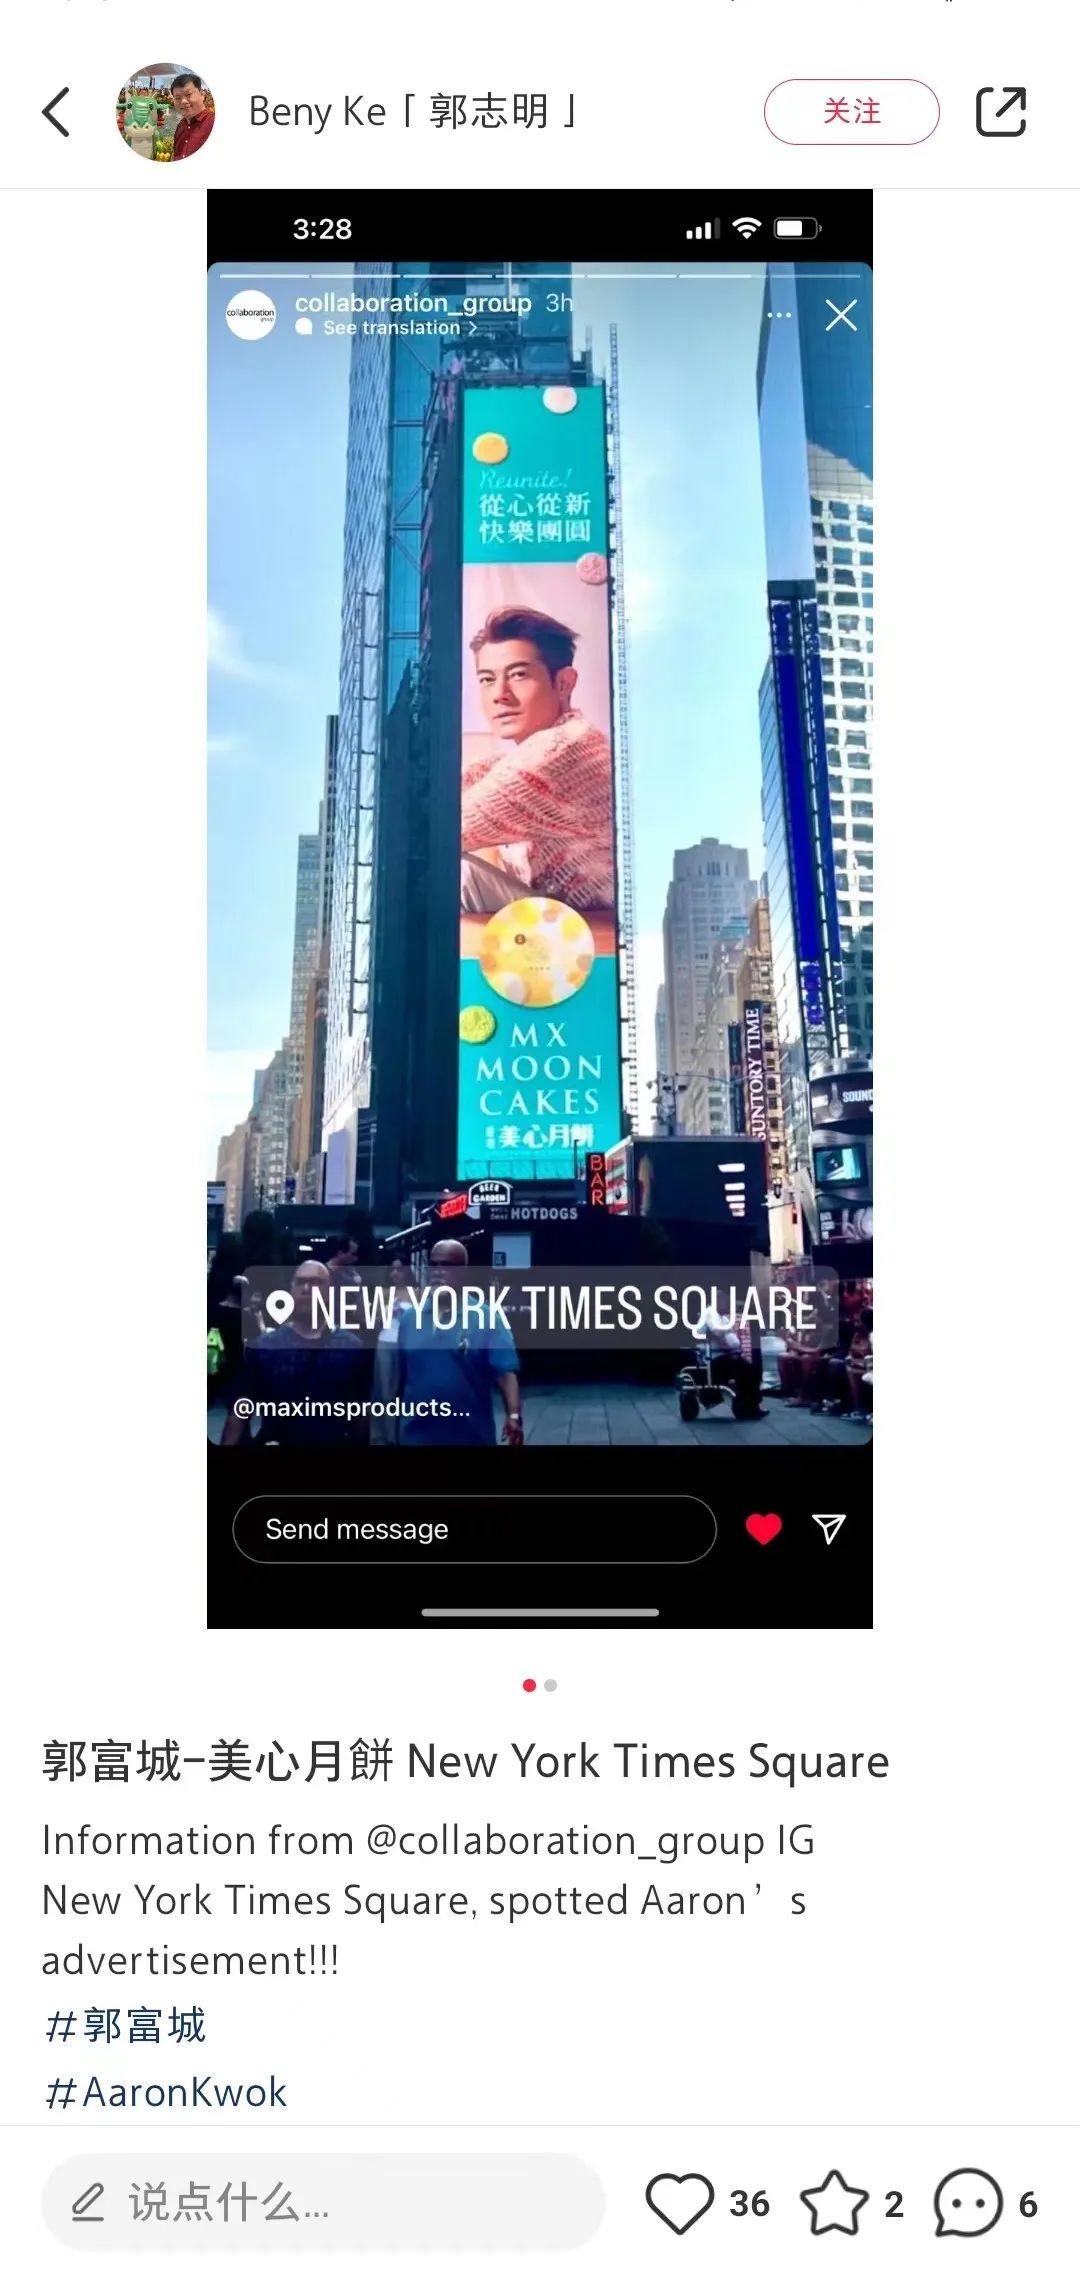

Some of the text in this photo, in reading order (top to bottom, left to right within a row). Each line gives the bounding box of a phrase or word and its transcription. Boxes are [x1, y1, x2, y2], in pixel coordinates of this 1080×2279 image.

[479, 491, 592, 517] 從心從新
[479, 518, 592, 544] 快樂團圓
[510, 1021, 568, 1048] MX
[745, 1007, 761, 1053] TIME
[476, 1055, 602, 1082] MOON
[479, 1087, 600, 1116] CAKES
[590, 1154, 605, 1206] BAR
[472, 1193, 507, 1204] GARDEN
